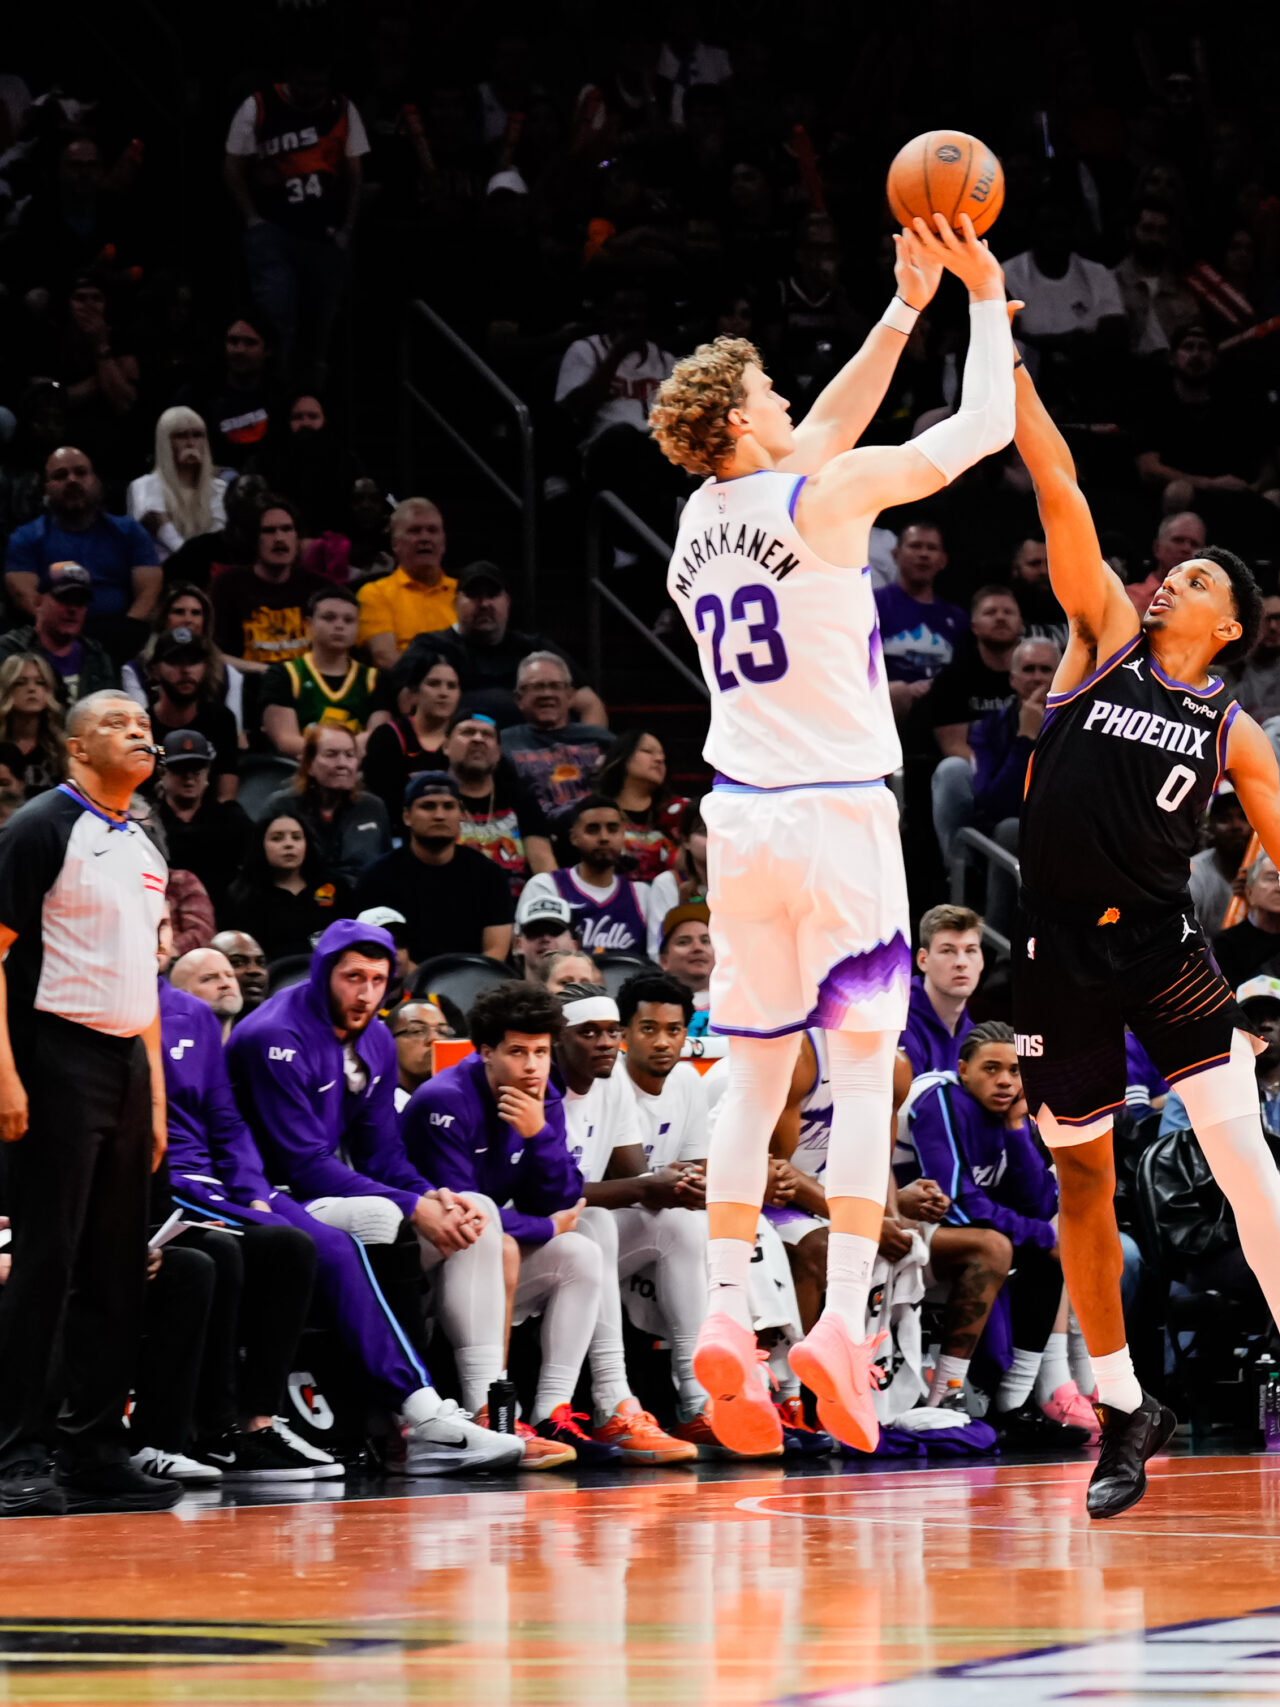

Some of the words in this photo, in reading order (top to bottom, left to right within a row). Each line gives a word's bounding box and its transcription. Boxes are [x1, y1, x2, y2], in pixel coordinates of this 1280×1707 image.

[285, 173, 322, 204] 34
[675, 522, 800, 599] MARKKANEN
[695, 583, 789, 694] 23
[1182, 696, 1217, 720] PayPal
[1082, 700, 1212, 760] PHOENIX
[1155, 763, 1197, 812] 0
[268, 1046, 296, 1062] LVT
[1014, 1034, 1044, 1058] UNS
[429, 1112, 456, 1129] LVT
